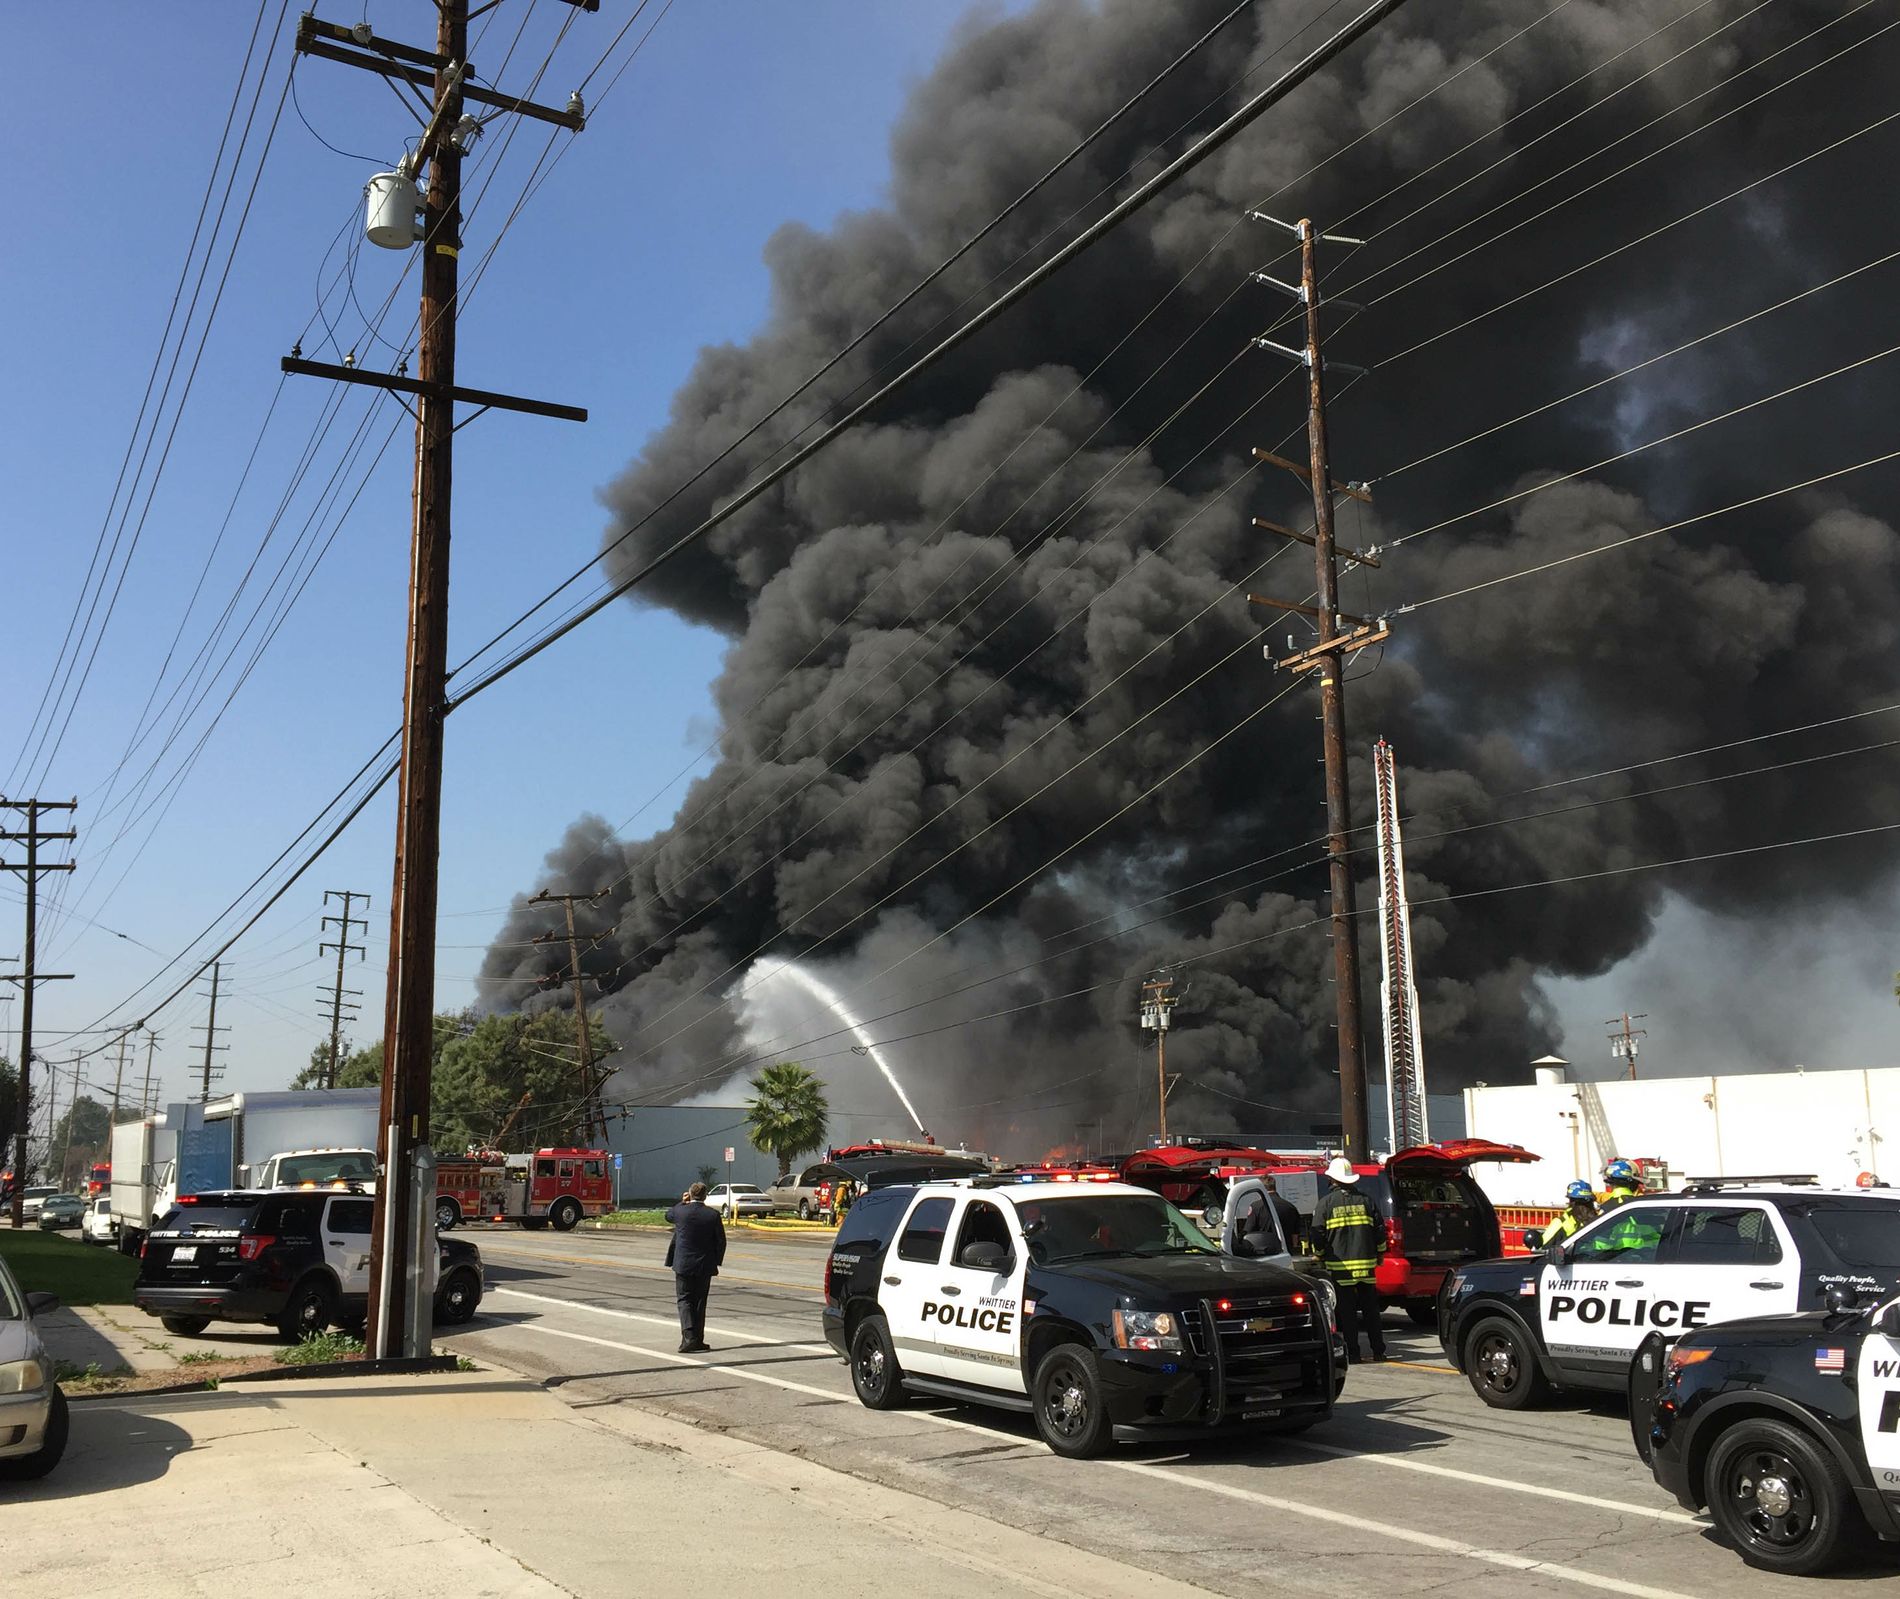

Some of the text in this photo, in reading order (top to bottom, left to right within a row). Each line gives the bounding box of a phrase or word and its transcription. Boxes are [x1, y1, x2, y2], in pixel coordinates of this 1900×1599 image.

[1547, 1280, 1609, 1291] WHITTIER
[1818, 1275, 1849, 1284] Quality
[1855, 1285, 1886, 1293] Service
[979, 1297, 1016, 1310] WHITTIER
[921, 1302, 1015, 1334] POLICE
[1548, 1296, 1711, 1329] POLICE
